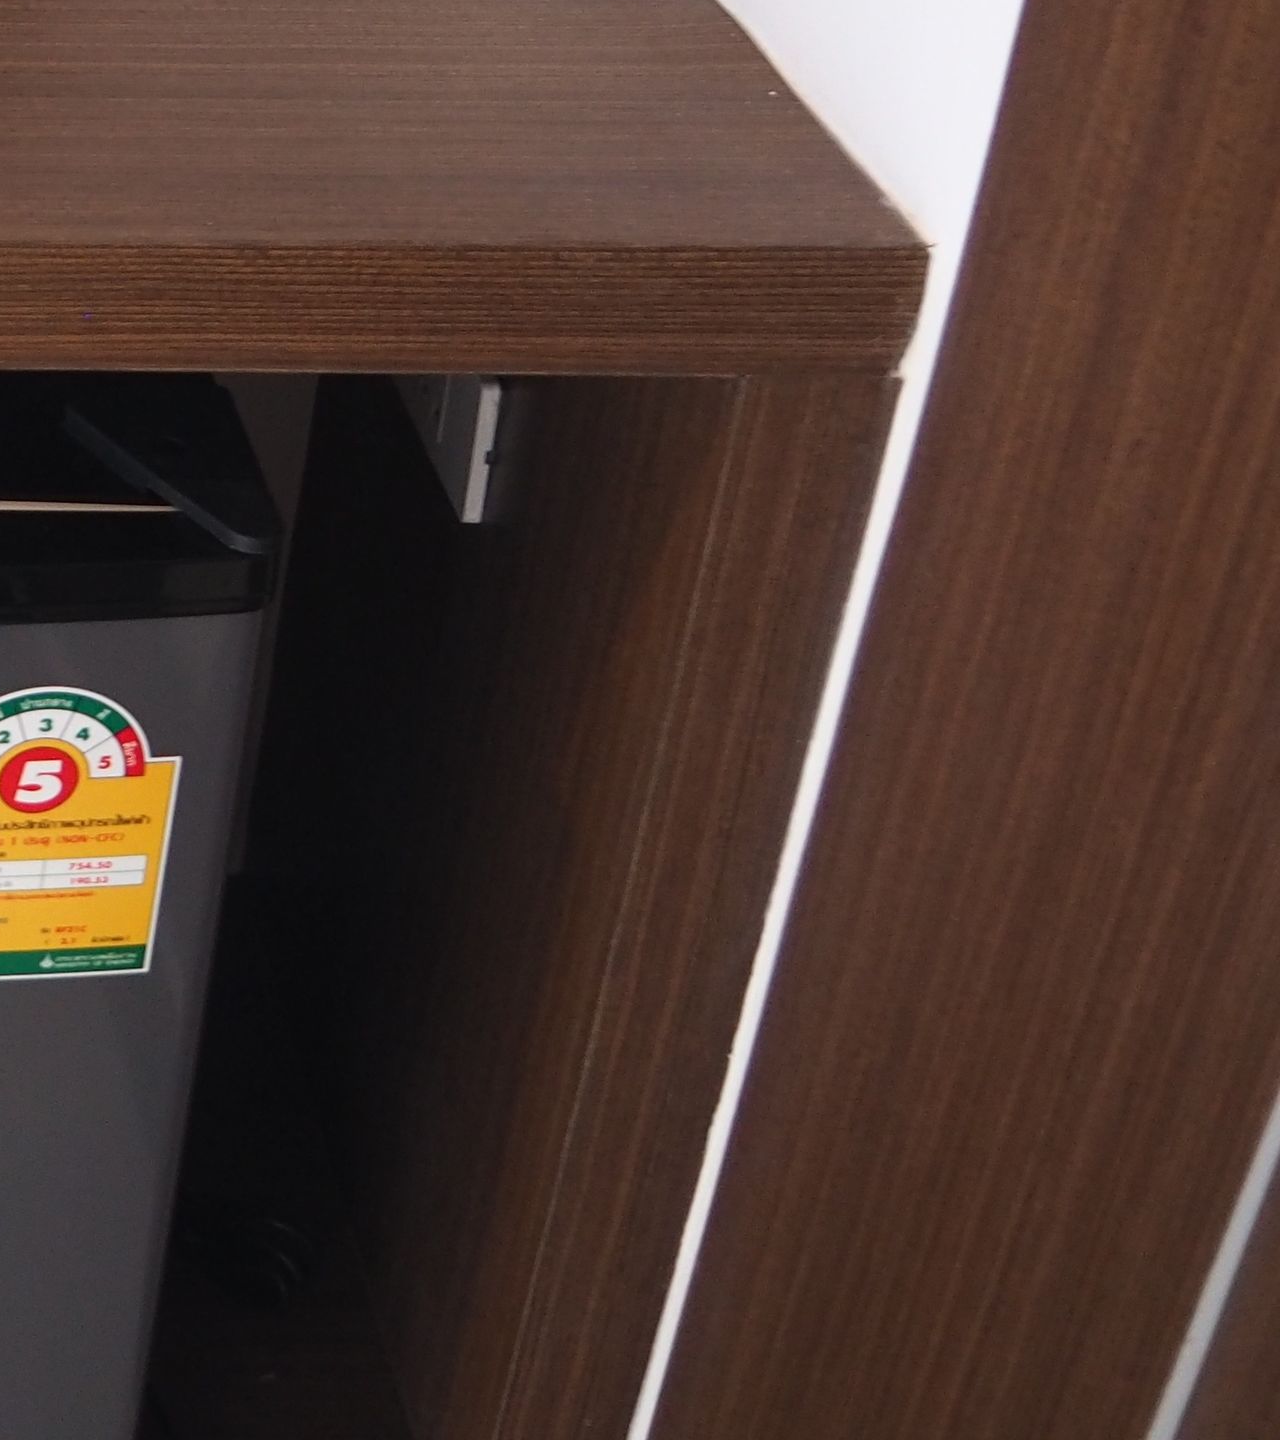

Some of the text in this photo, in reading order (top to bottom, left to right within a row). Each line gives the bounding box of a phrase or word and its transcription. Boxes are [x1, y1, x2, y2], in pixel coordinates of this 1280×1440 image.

[39, 718, 53, 732] 3
[76, 727, 91, 741] 4
[97, 755, 112, 769] 5
[12, 760, 64, 804] 5
